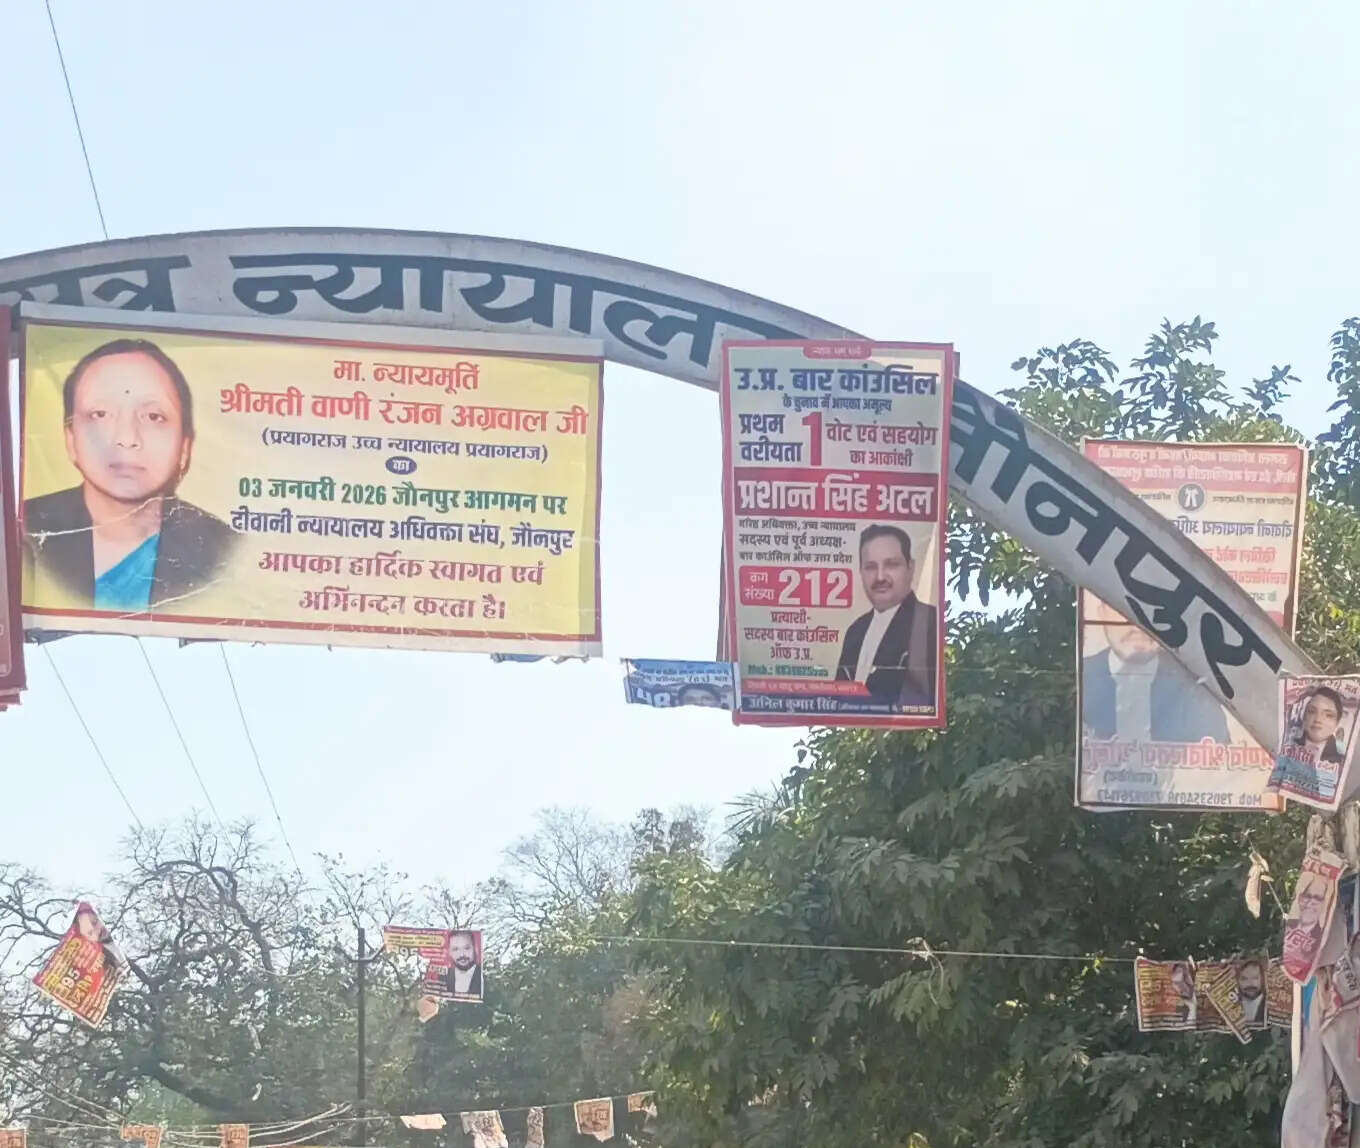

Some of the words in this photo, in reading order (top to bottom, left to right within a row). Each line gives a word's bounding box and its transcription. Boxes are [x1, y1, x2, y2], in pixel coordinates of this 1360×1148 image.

[229, 253, 810, 368] न्यायाल
[334, 359, 366, 385] मा.
[375, 359, 480, 396] न्यायमूर्ति
[735, 366, 784, 391] उ.प्र.
[790, 368, 834, 392] बार
[221, 383, 305, 418] श्रीमती
[311, 389, 371, 421] वाणी
[379, 391, 442, 426] रंजन
[451, 404, 547, 432] अग्रवाल
[555, 403, 588, 436] जी
[739, 413, 784, 434] प्रथम
[352, 432, 383, 452] उच्च
[387, 437, 460, 458] न्यायालय
[739, 435, 803, 462] वरीयता
[802, 411, 822, 466] 1
[826, 420, 853, 441] वोट
[857, 420, 878, 443] एवं
[881, 421, 938, 445] सहयोग
[849, 450, 866, 465] का
[239, 477, 262, 499] 03
[269, 475, 335, 502] जनवरी
[342, 483, 387, 505] 2026
[393, 481, 460, 514] जौनपुर
[466, 490, 538, 513] आगमन
[543, 494, 567, 515] पर
[822, 473, 870, 513] सिंह
[875, 484, 934, 515] अटल
[231, 508, 292, 535] दीवानी
[297, 514, 383, 541] न्यायालय
[390, 516, 464, 546] अधिवक्ता
[468, 522, 506, 549] संघ,
[511, 523, 574, 556] जौनपुर
[259, 550, 342, 576] आपका
[347, 551, 423, 582] हार्दिक
[428, 560, 502, 584] स्वागत
[511, 559, 544, 587] एवं
[298, 585, 405, 613] अभिनन्दन
[414, 593, 474, 619] करता
[779, 569, 848, 606] 212
[744, 627, 775, 642] सदस्य
